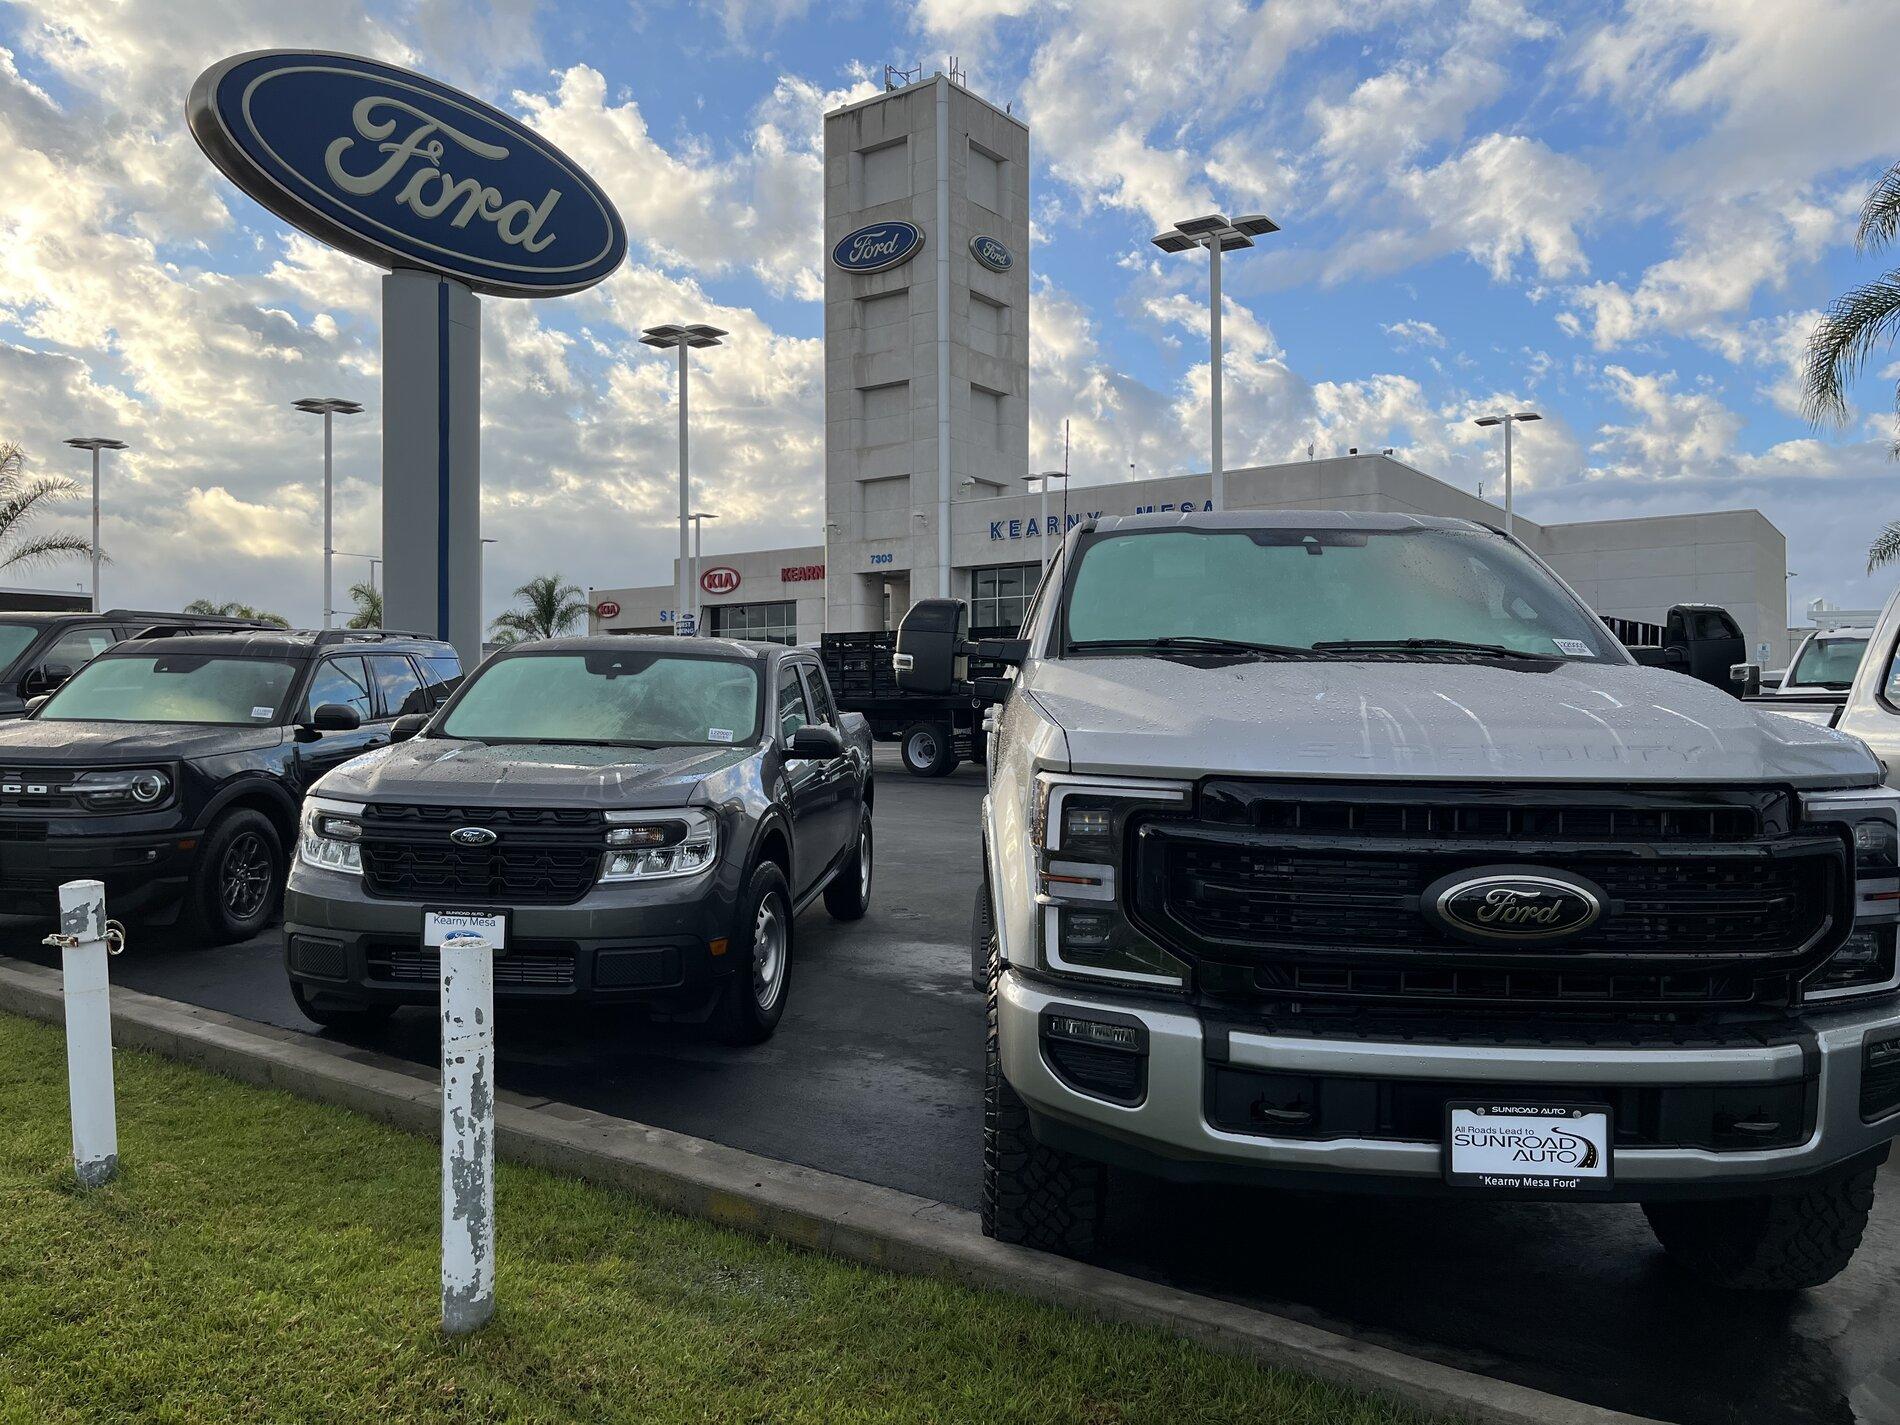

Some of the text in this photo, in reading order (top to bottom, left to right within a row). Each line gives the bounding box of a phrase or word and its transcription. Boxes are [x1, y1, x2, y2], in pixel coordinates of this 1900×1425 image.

[324, 96, 562, 254] Ford
[849, 230, 900, 263] Ford
[983, 241, 1007, 265] Ford
[870, 554, 893, 564] 7303
[706, 572, 734, 589] KIA
[781, 565, 825, 583] KEARN
[600, 604, 617, 615] KIA
[460, 831, 486, 842] Ford
[1476, 888, 1563, 924] Ford
[433, 915, 497, 927] Kearny Mesa
[1491, 1106, 1566, 1115] SUNROAD AUTO
[1467, 1126, 1497, 1135] Roads
[1499, 1127, 1523, 1135] Lead
[1454, 1134, 1577, 1150] SUNROAD
[1512, 1149, 1577, 1164] AUTO
[1484, 1176, 1576, 1188] Kearny Mesa Ford
